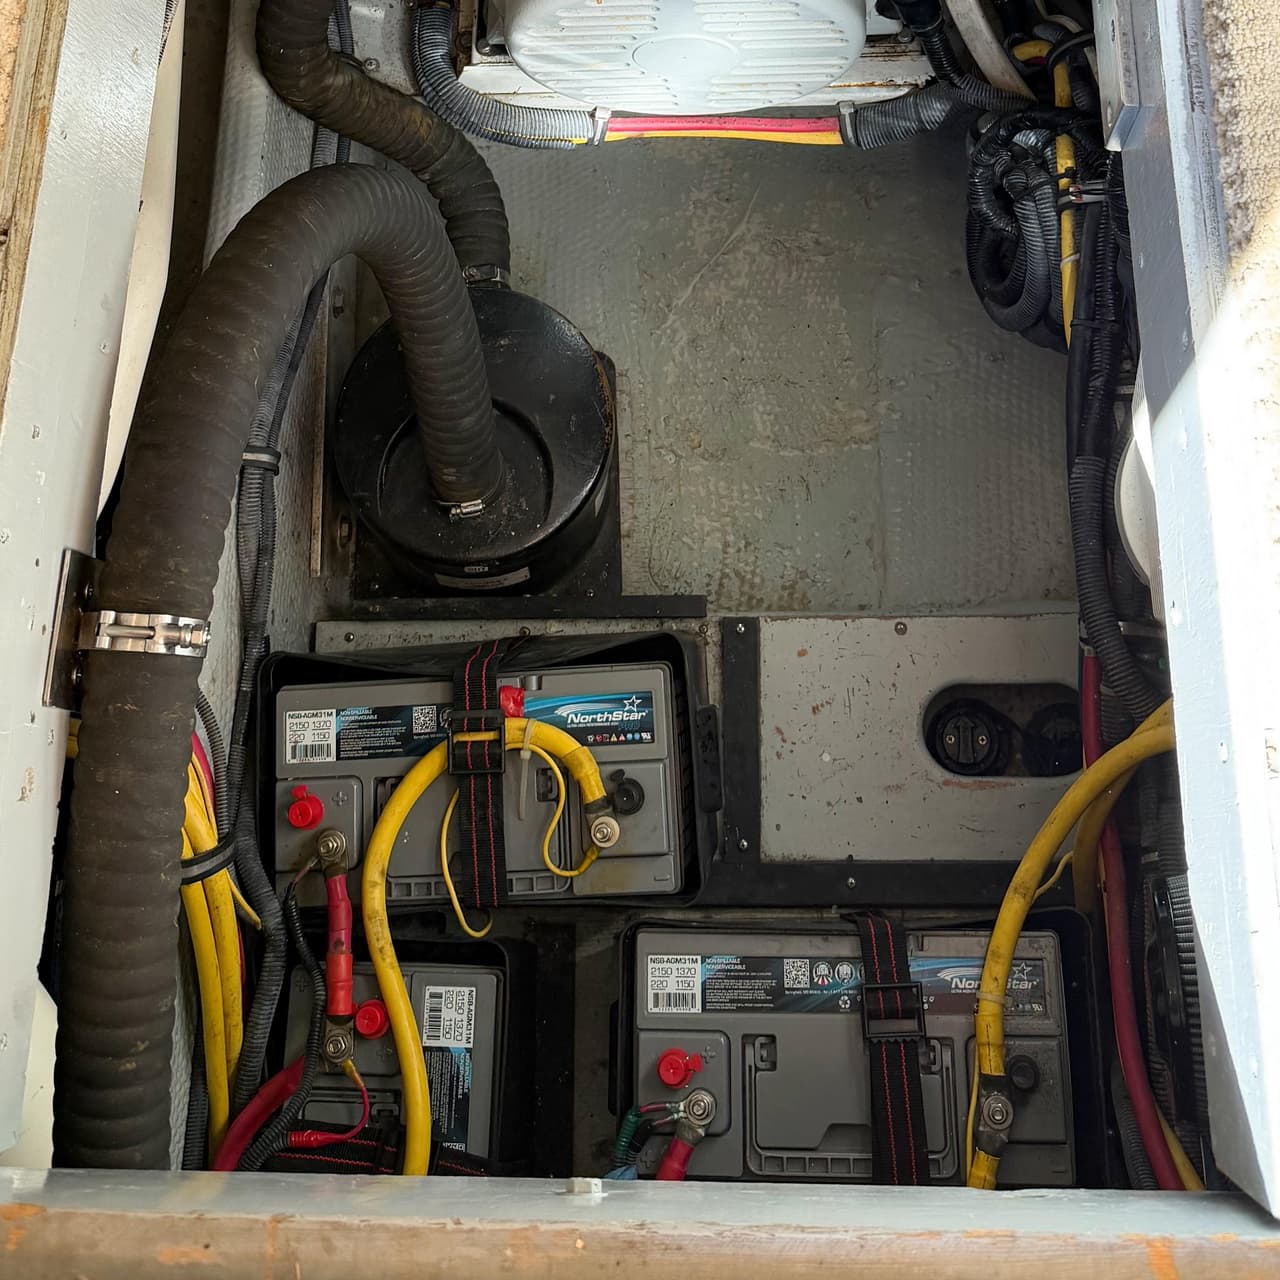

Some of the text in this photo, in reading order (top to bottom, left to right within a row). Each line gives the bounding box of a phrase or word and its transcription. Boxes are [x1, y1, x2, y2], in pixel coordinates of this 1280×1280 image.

[567, 711, 646, 723] NorthStar
[289, 720, 332, 730] 2150 1370
[289, 731, 330, 741] 220 1150
[650, 967, 696, 976] 2150 1370
[650, 979, 695, 988] 220 1150
[444, 990, 455, 1040] 220 1150
[455, 990, 465, 1042] 2150 1370
